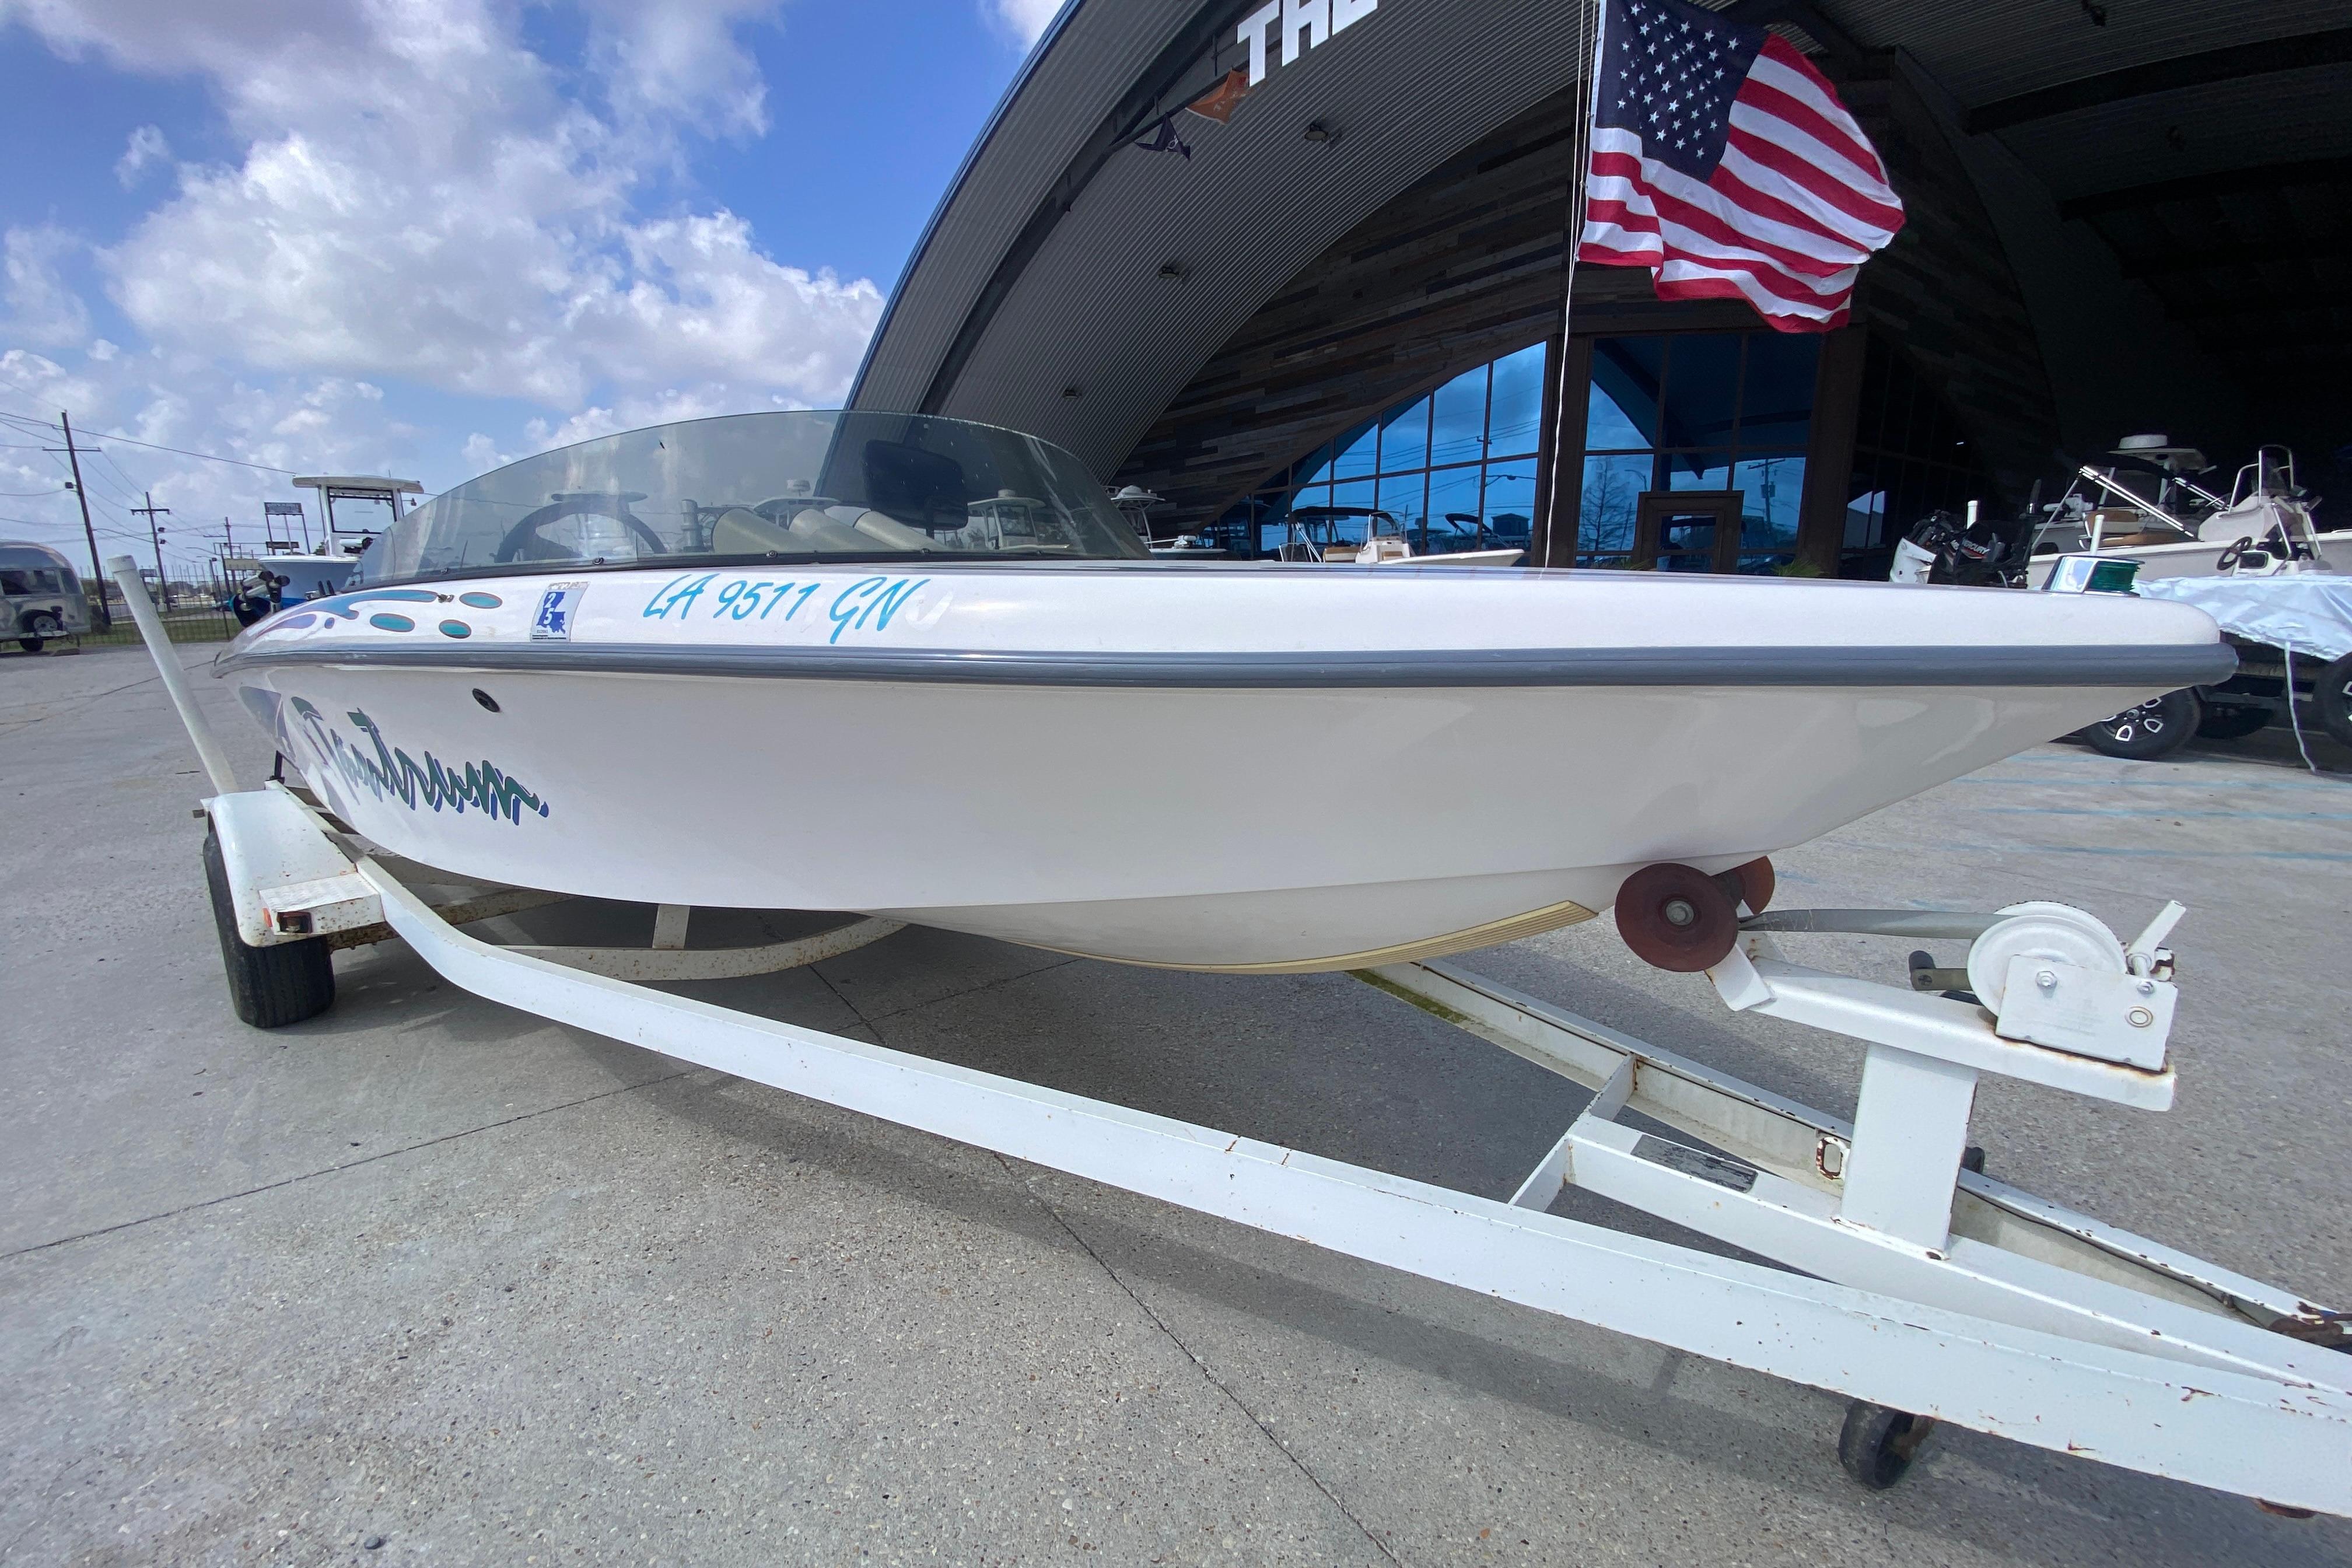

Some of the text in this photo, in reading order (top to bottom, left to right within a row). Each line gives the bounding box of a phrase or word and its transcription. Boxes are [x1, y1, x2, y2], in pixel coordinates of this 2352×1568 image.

[643, 573, 931, 645] LA 9511 GN
